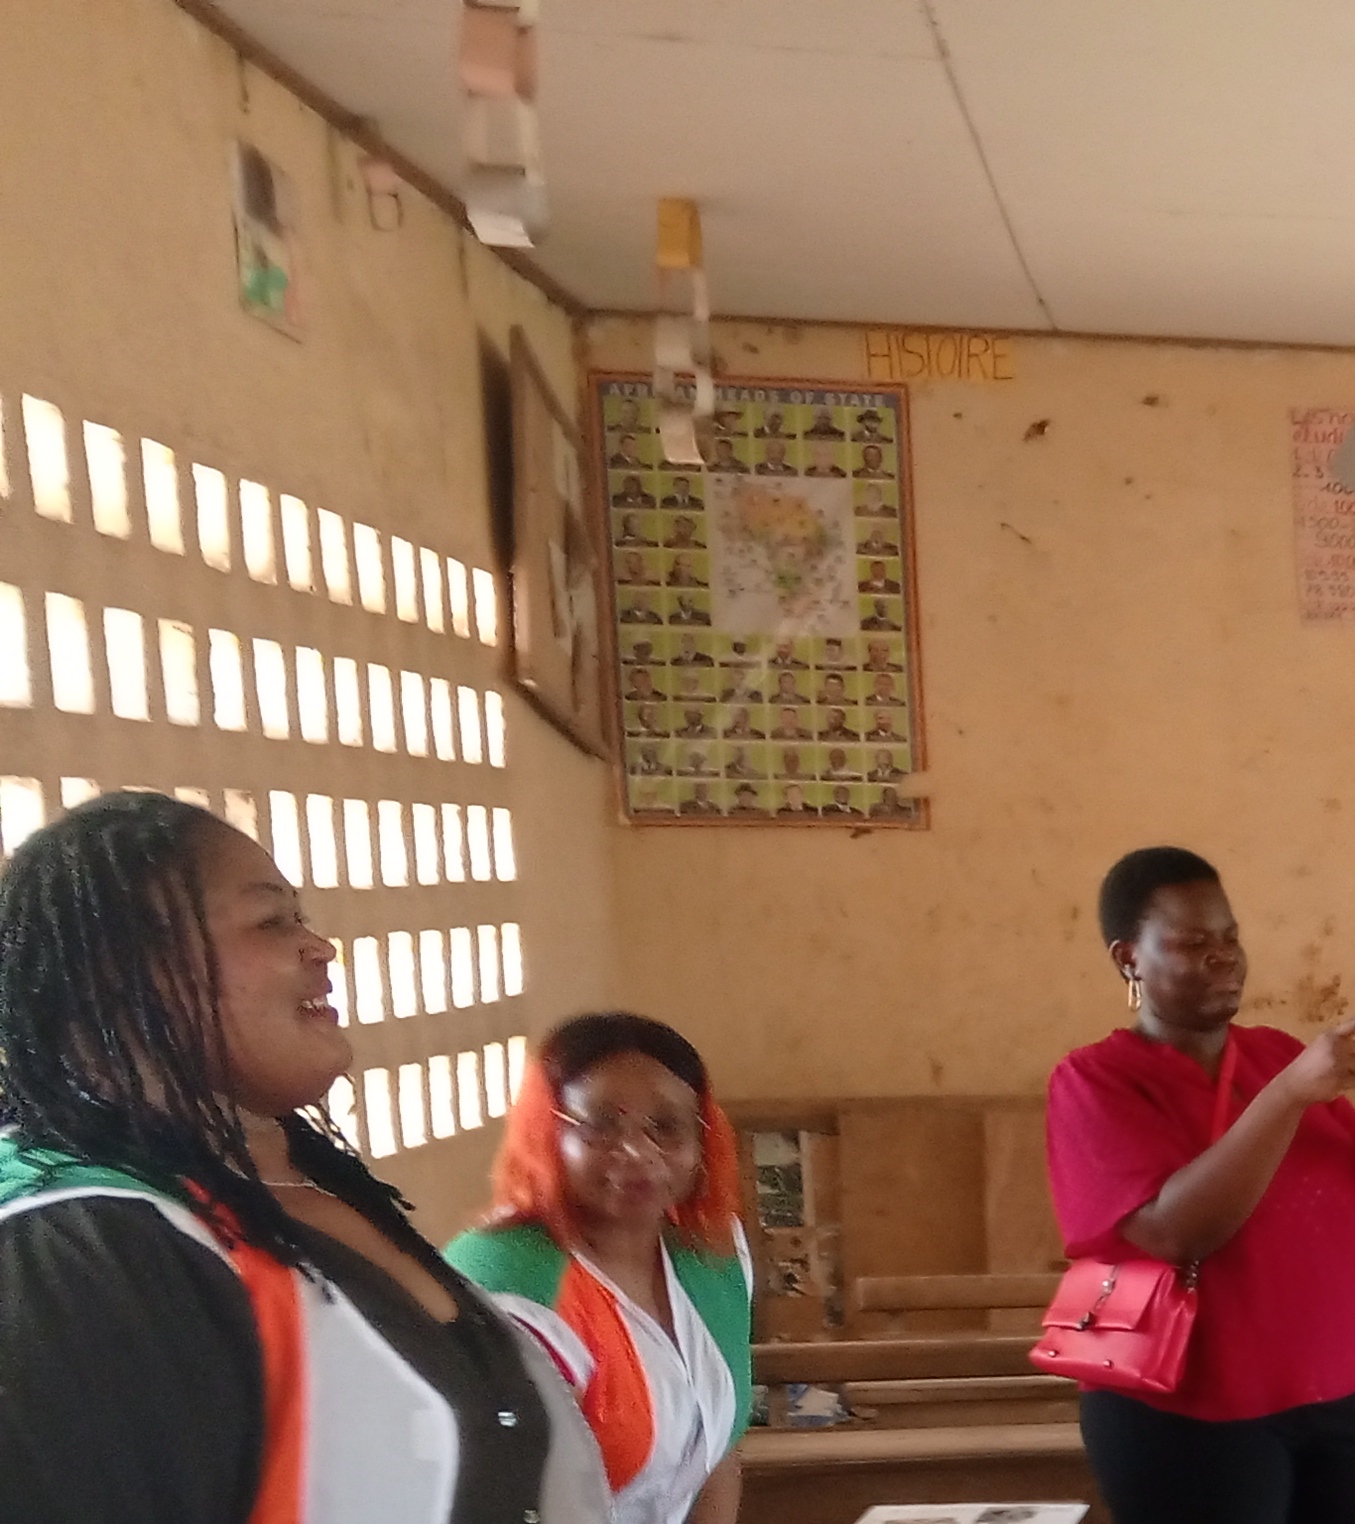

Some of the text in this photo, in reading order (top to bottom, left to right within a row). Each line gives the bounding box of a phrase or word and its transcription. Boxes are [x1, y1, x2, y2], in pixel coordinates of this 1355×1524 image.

[863, 332, 1015, 381] HISTOIRE
[790, 390, 814, 405] OF
[824, 393, 884, 408] STATE
